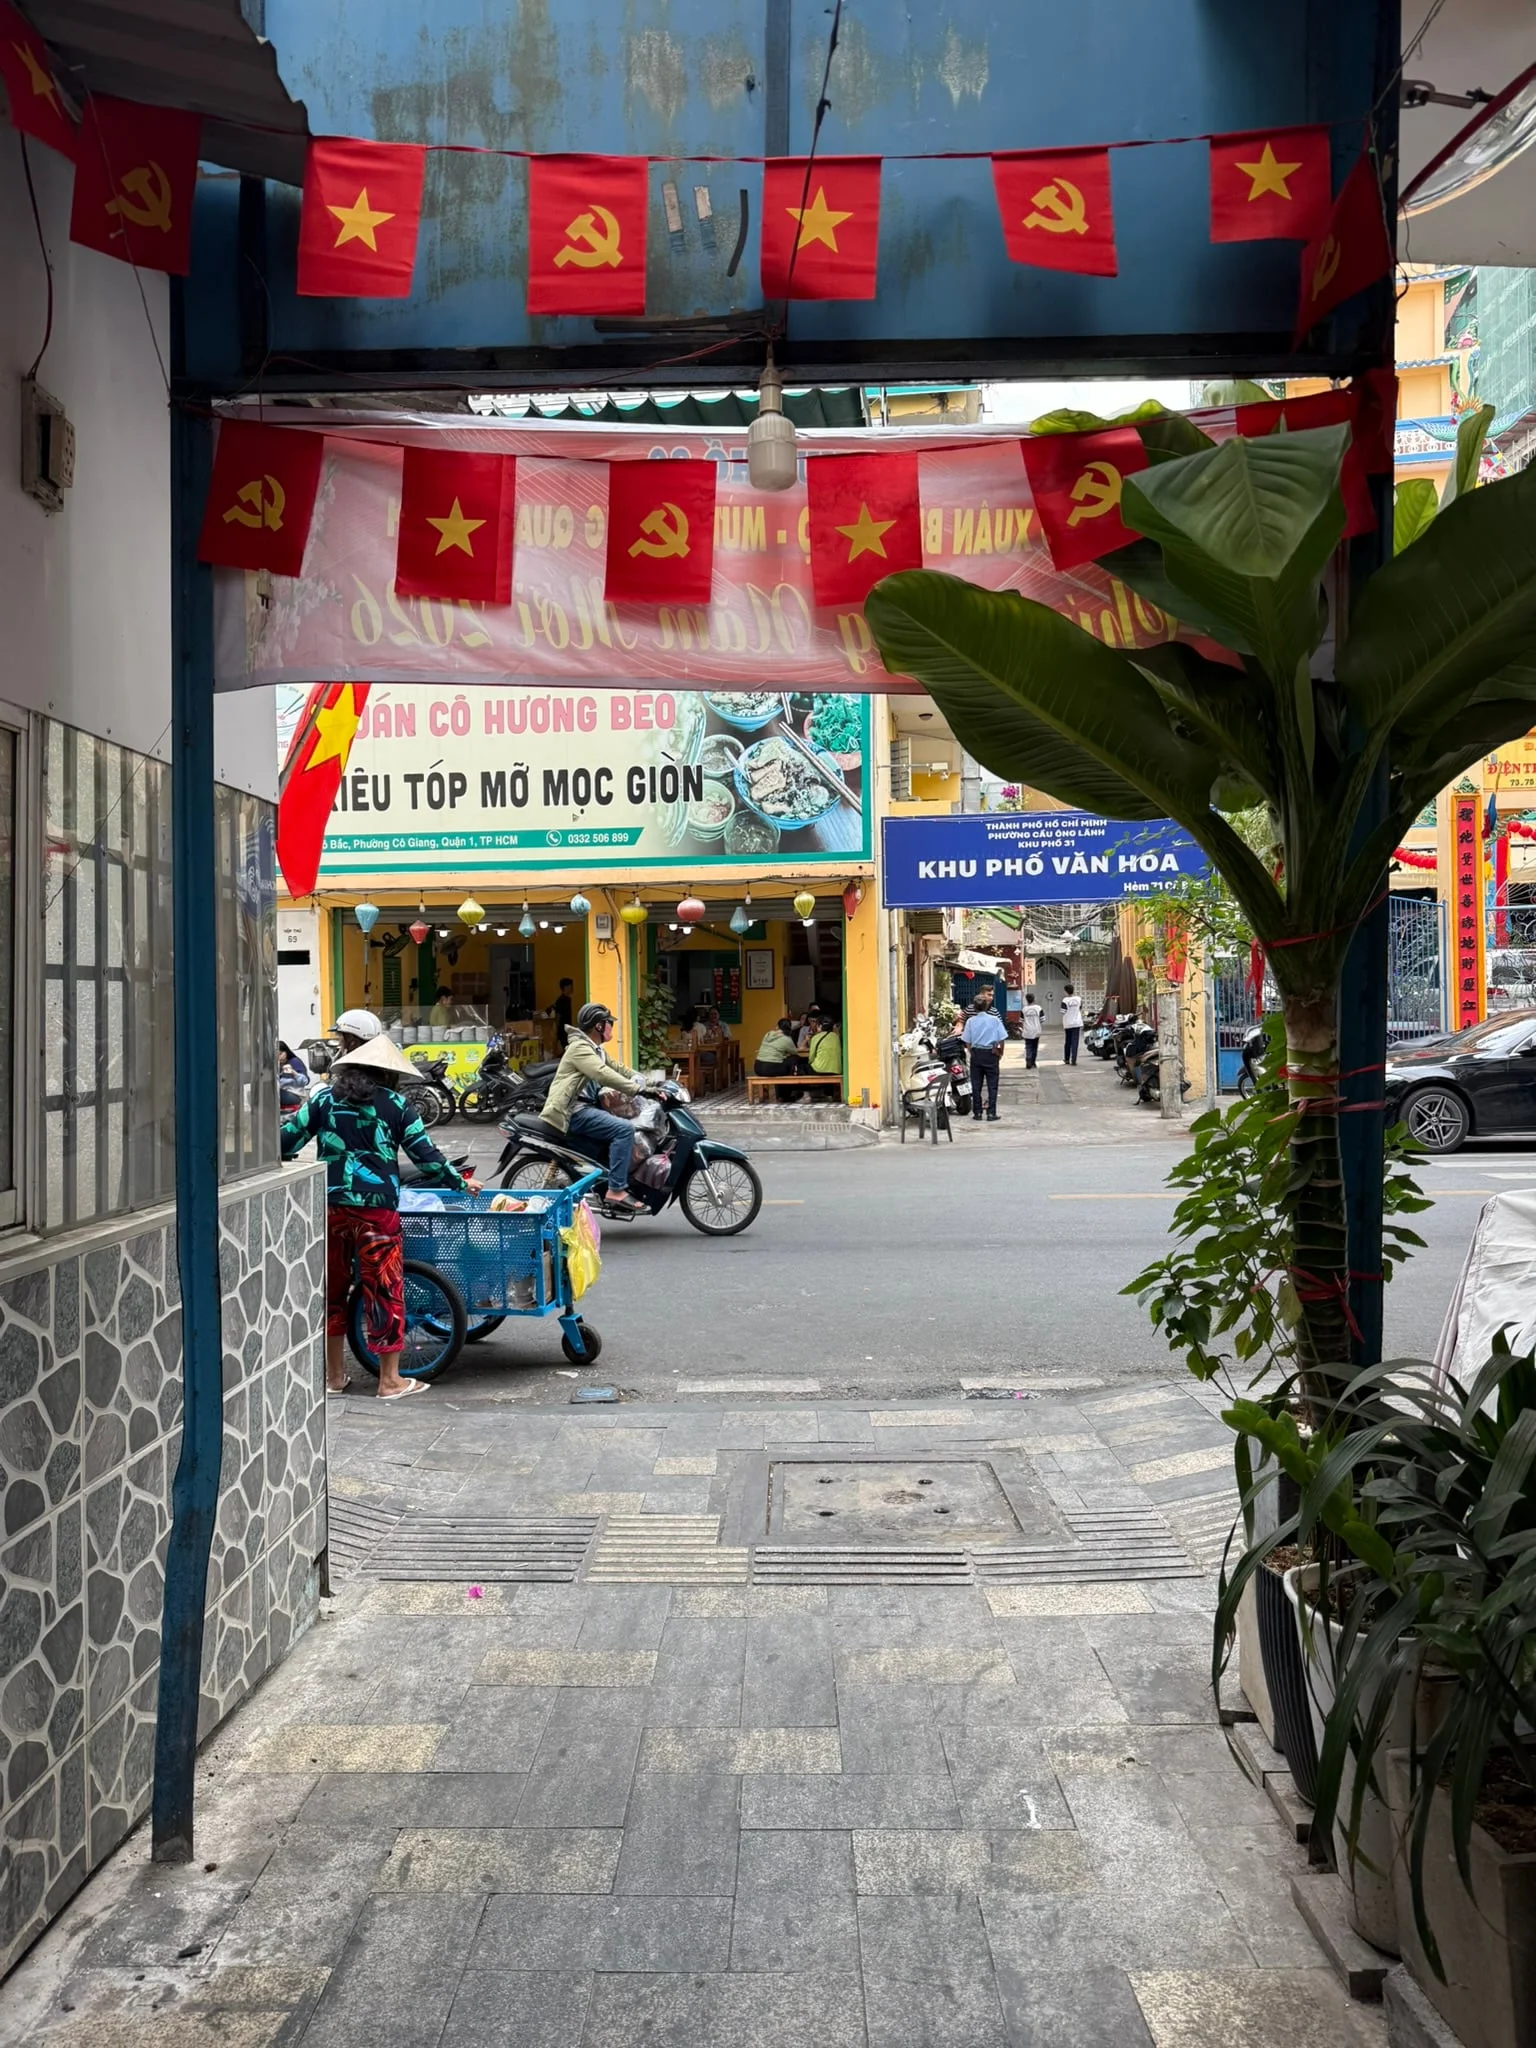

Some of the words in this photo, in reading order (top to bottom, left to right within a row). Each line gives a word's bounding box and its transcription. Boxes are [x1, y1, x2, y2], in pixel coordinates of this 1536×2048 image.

[429, 695, 471, 736] CÔ
[484, 694, 598, 735] HƯƠNG
[403, 759, 468, 810] TÓP
[480, 762, 530, 808] MỠ
[543, 766, 614, 814] MỌC
[627, 752, 703, 805] GIÒN
[1080, 819, 1107, 828] MINH
[392, 837, 405, 848] Cô
[441, 836, 466, 849] Quận
[479, 836, 492, 846] TP
[495, 835, 518, 845] HCM
[568, 834, 590, 844] 0332
[592, 834, 610, 843] 506
[611, 833, 629, 843] 899
[1018, 841, 1039, 849] KHU
[1041, 838, 1062, 848] PHỐ
[1064, 839, 1075, 847] 31
[918, 858, 977, 879] KHU
[986, 851, 1044, 877] PHỐ
[1051, 851, 1109, 875] VĂN
